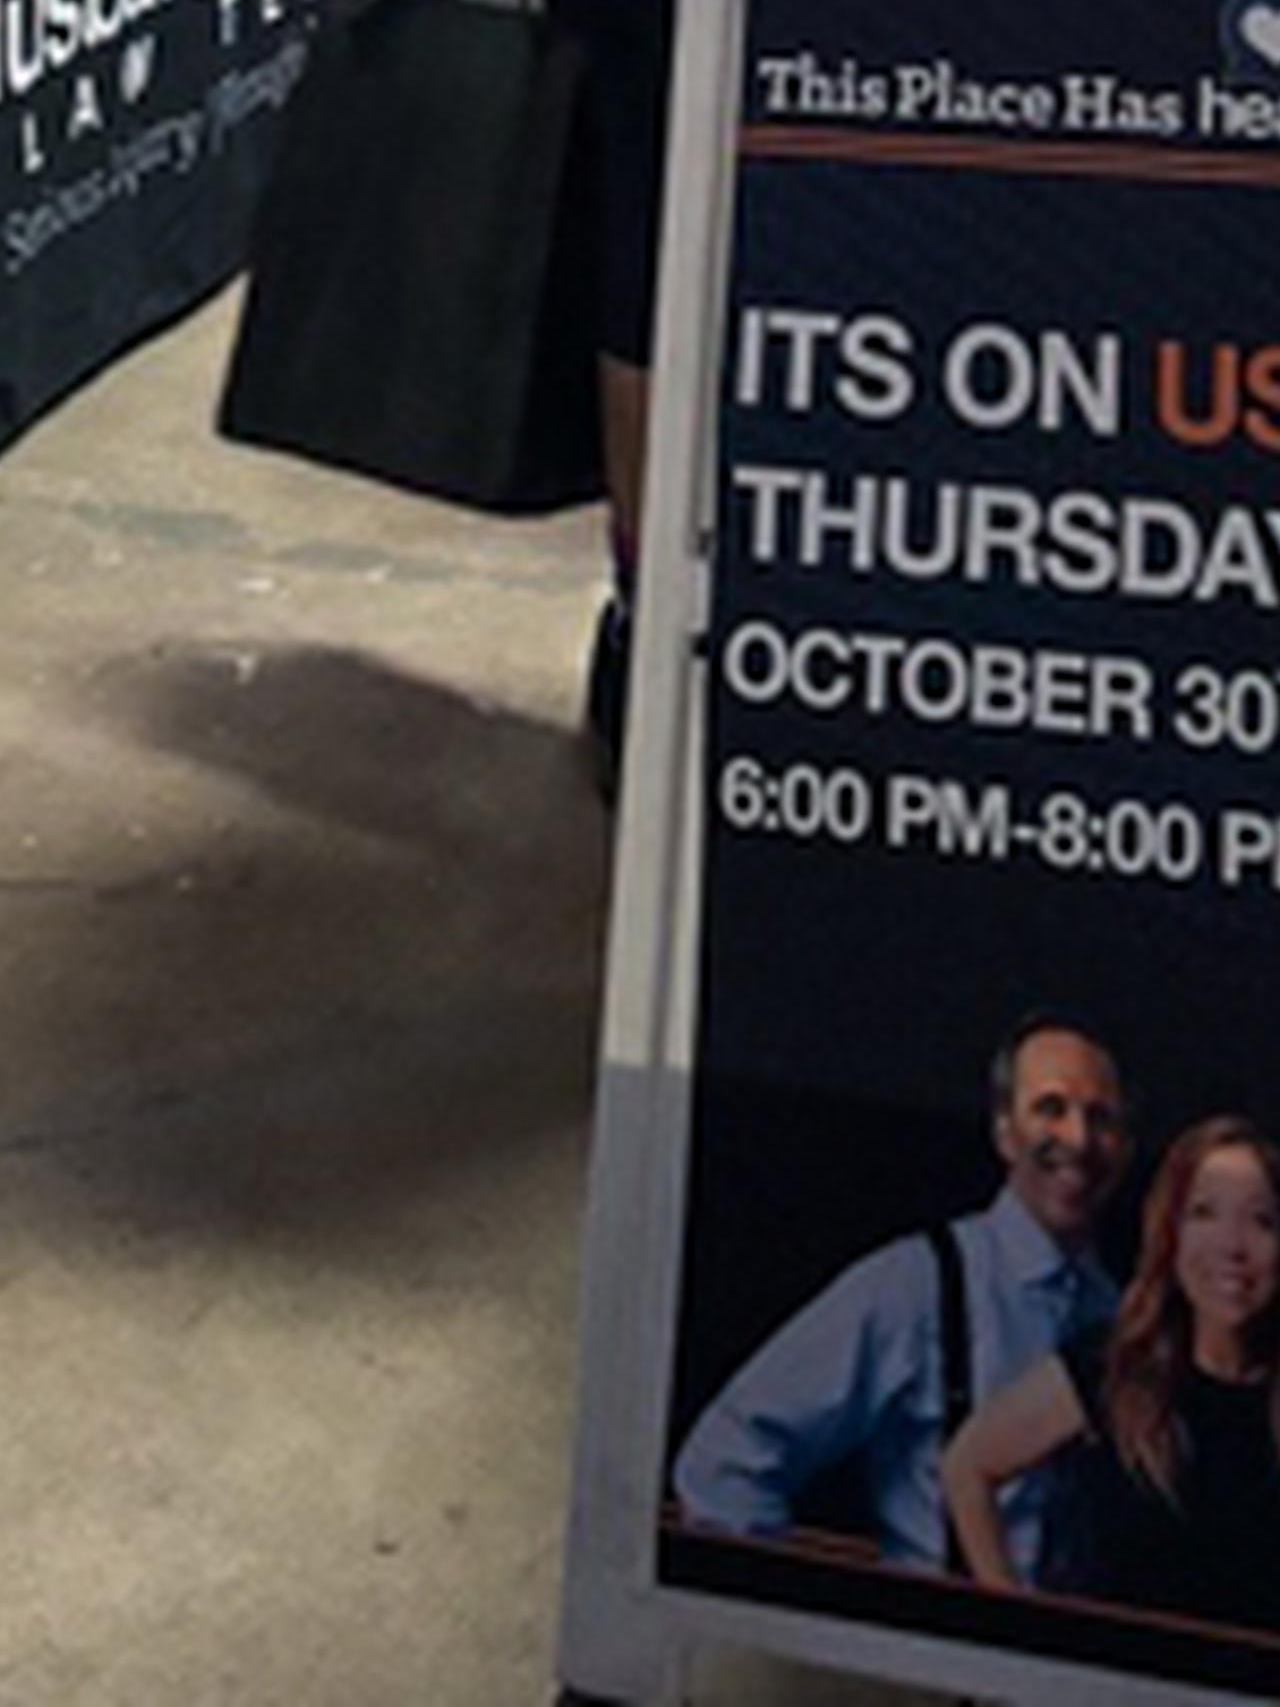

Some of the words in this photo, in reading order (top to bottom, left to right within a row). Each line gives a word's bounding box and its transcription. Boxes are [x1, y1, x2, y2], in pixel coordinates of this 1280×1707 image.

[757, 52, 889, 119] This
[894, 58, 1056, 129] Place
[1060, 75, 1183, 135] Has
[734, 307, 913, 421] ITS
[944, 322, 1121, 437] ON
[723, 619, 1154, 739] OCTOBER
[718, 755, 872, 843] 6:00
